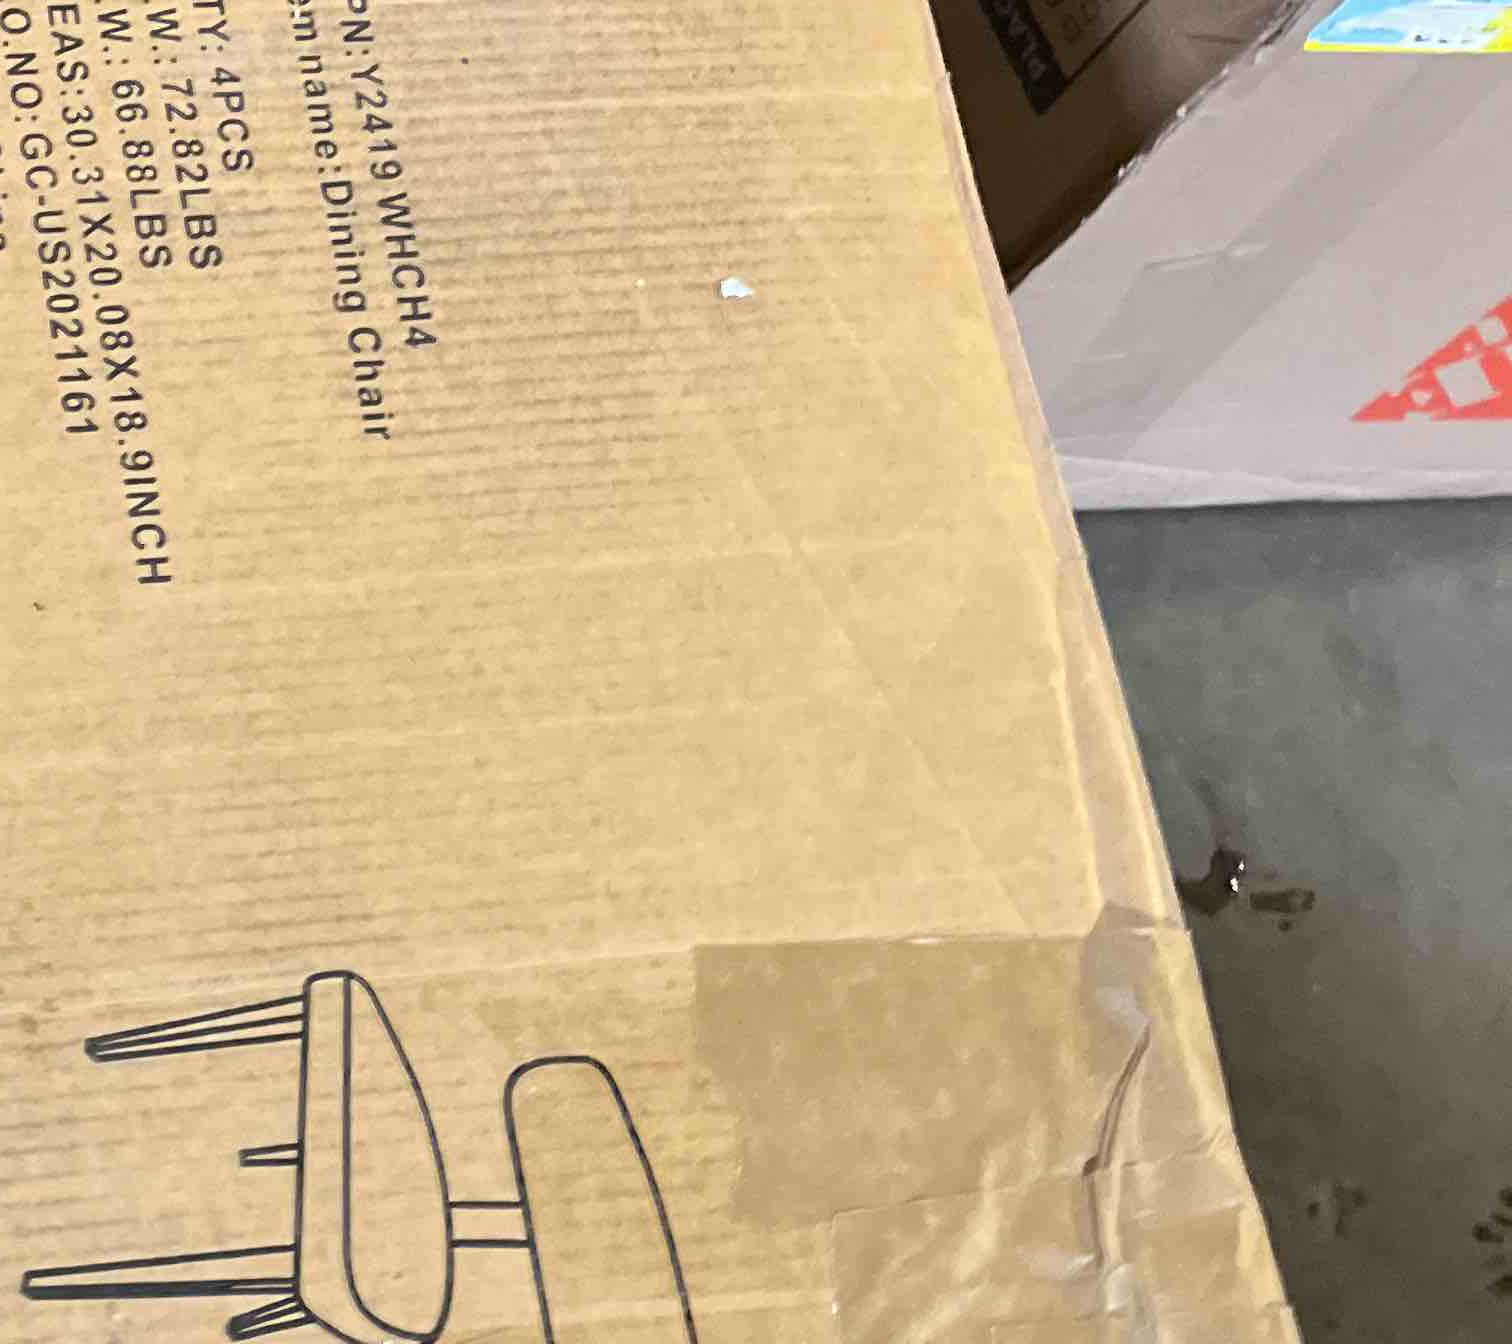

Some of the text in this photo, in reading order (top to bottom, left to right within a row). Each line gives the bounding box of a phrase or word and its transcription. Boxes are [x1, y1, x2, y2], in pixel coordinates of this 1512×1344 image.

[112, 78, 173, 269] 66.88LBS
[160, 78, 223, 269] 72.82LBS
[210, 65, 254, 173] 4PCS
[376, 190, 437, 348] WHCH4
[347, 326, 393, 440] Chair
